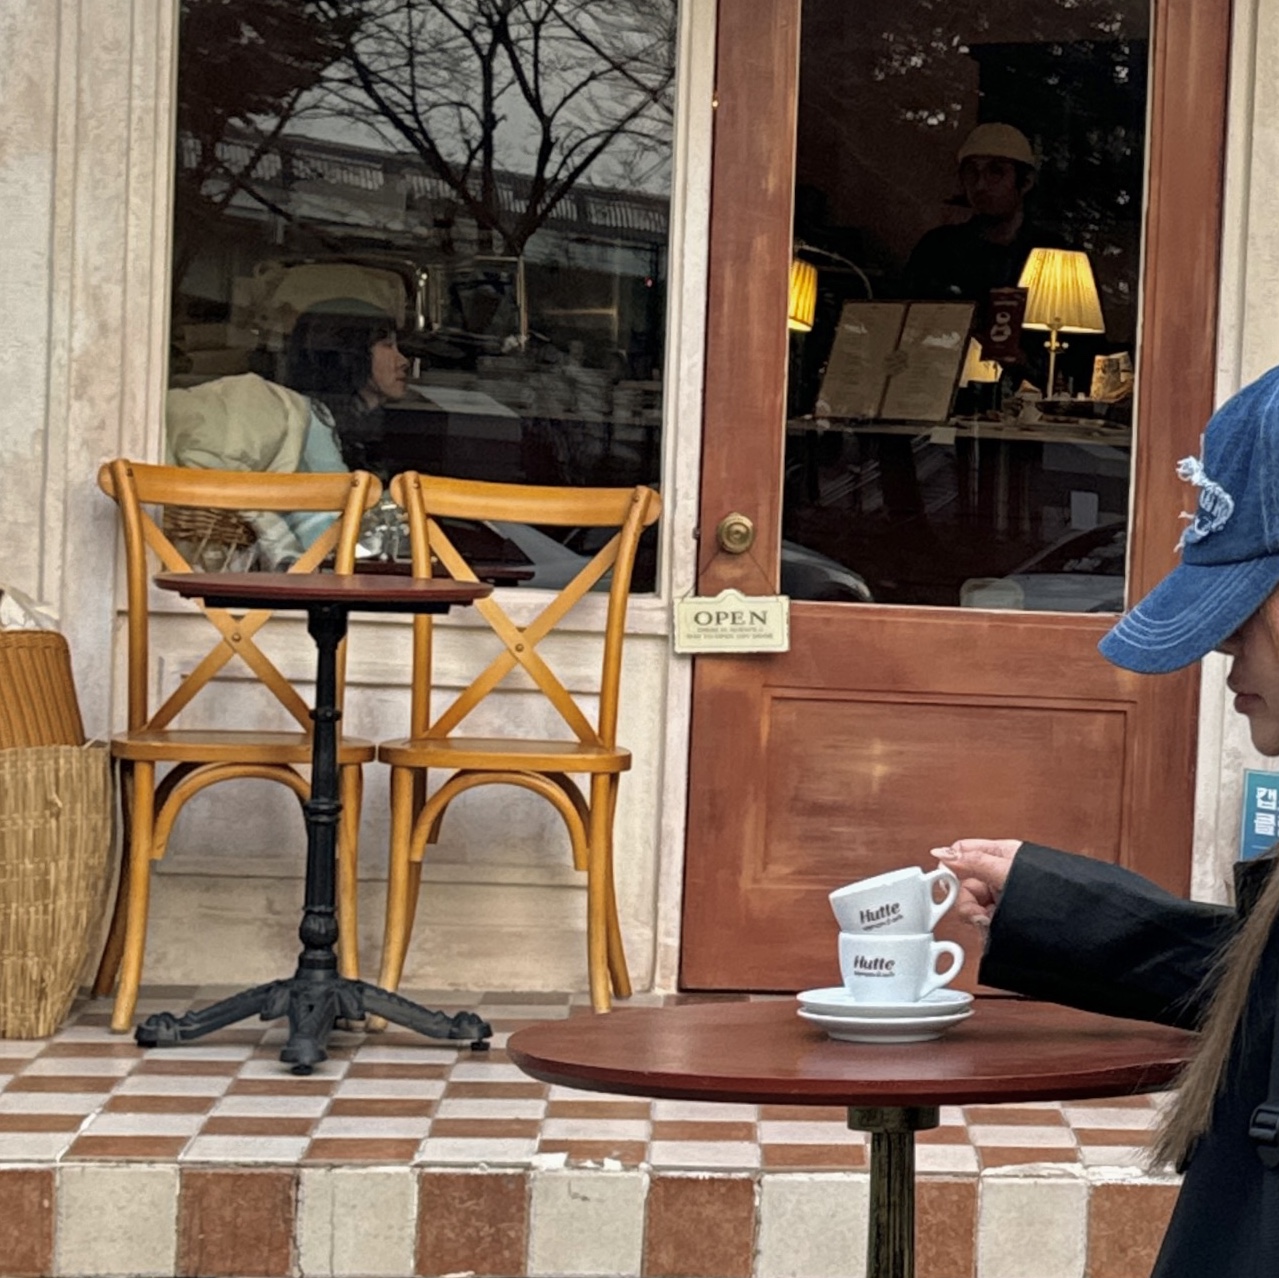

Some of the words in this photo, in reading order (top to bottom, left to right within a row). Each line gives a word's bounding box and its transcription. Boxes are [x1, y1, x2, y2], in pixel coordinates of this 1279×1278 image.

[693, 610, 768, 626] OPEN
[859, 903, 900, 924] Hutte
[854, 955, 895, 971] Hutte
